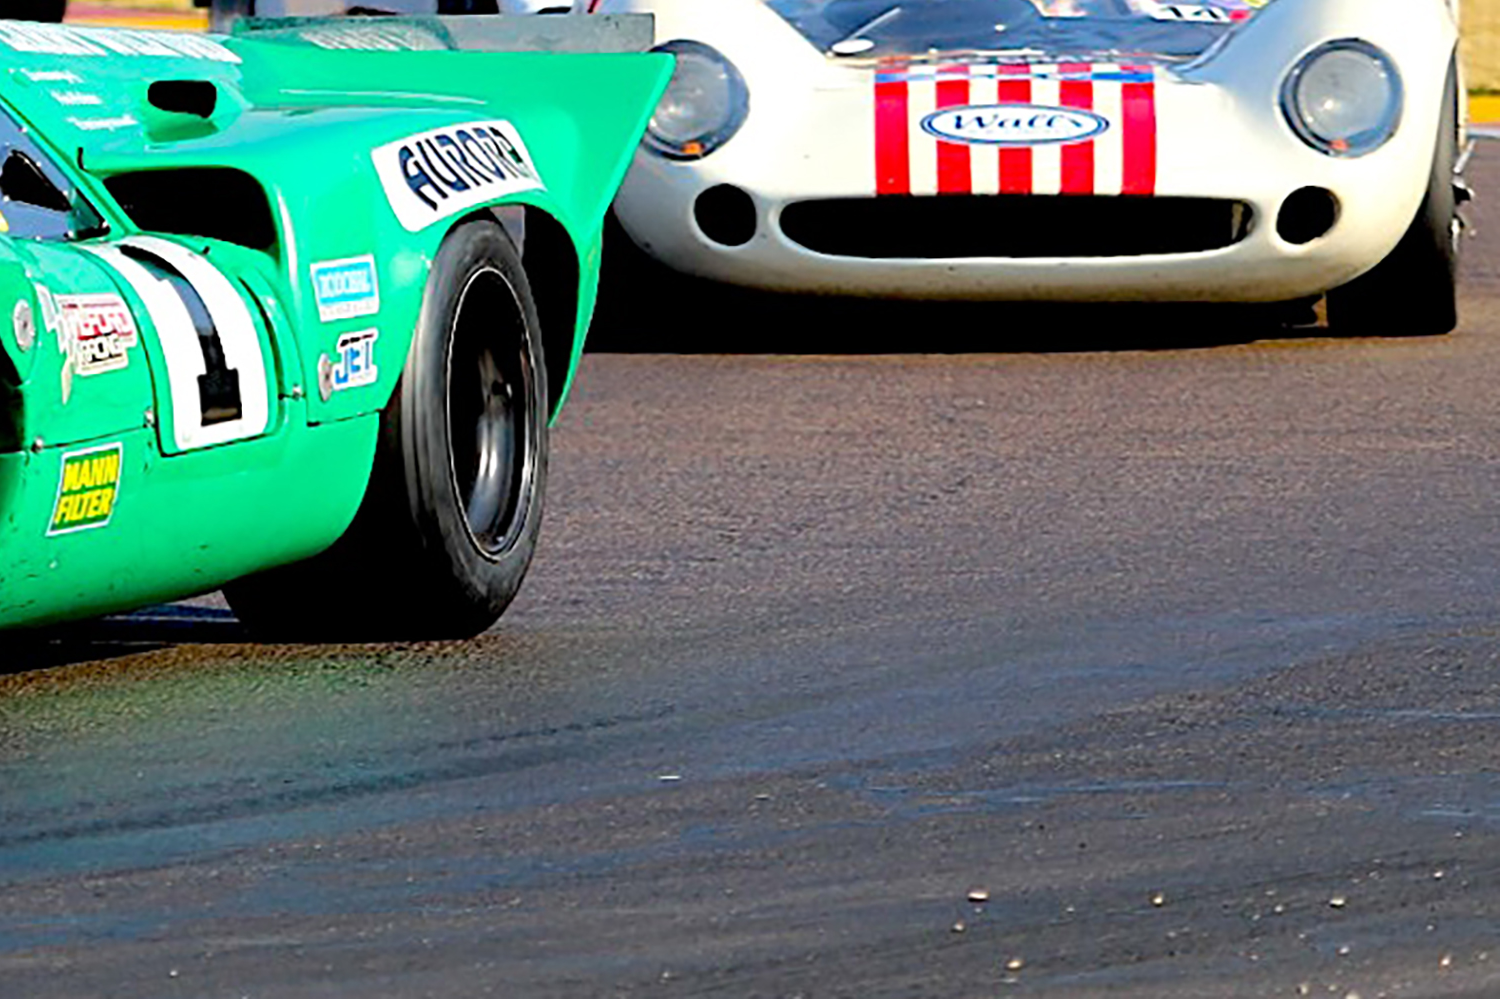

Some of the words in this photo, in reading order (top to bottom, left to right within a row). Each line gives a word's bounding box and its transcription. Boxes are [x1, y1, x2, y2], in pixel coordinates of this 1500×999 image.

[398, 125, 536, 212] AURORA
[116, 243, 243, 427] 1
[62, 453, 120, 493] MANN
[54, 487, 115, 525] FILTER
